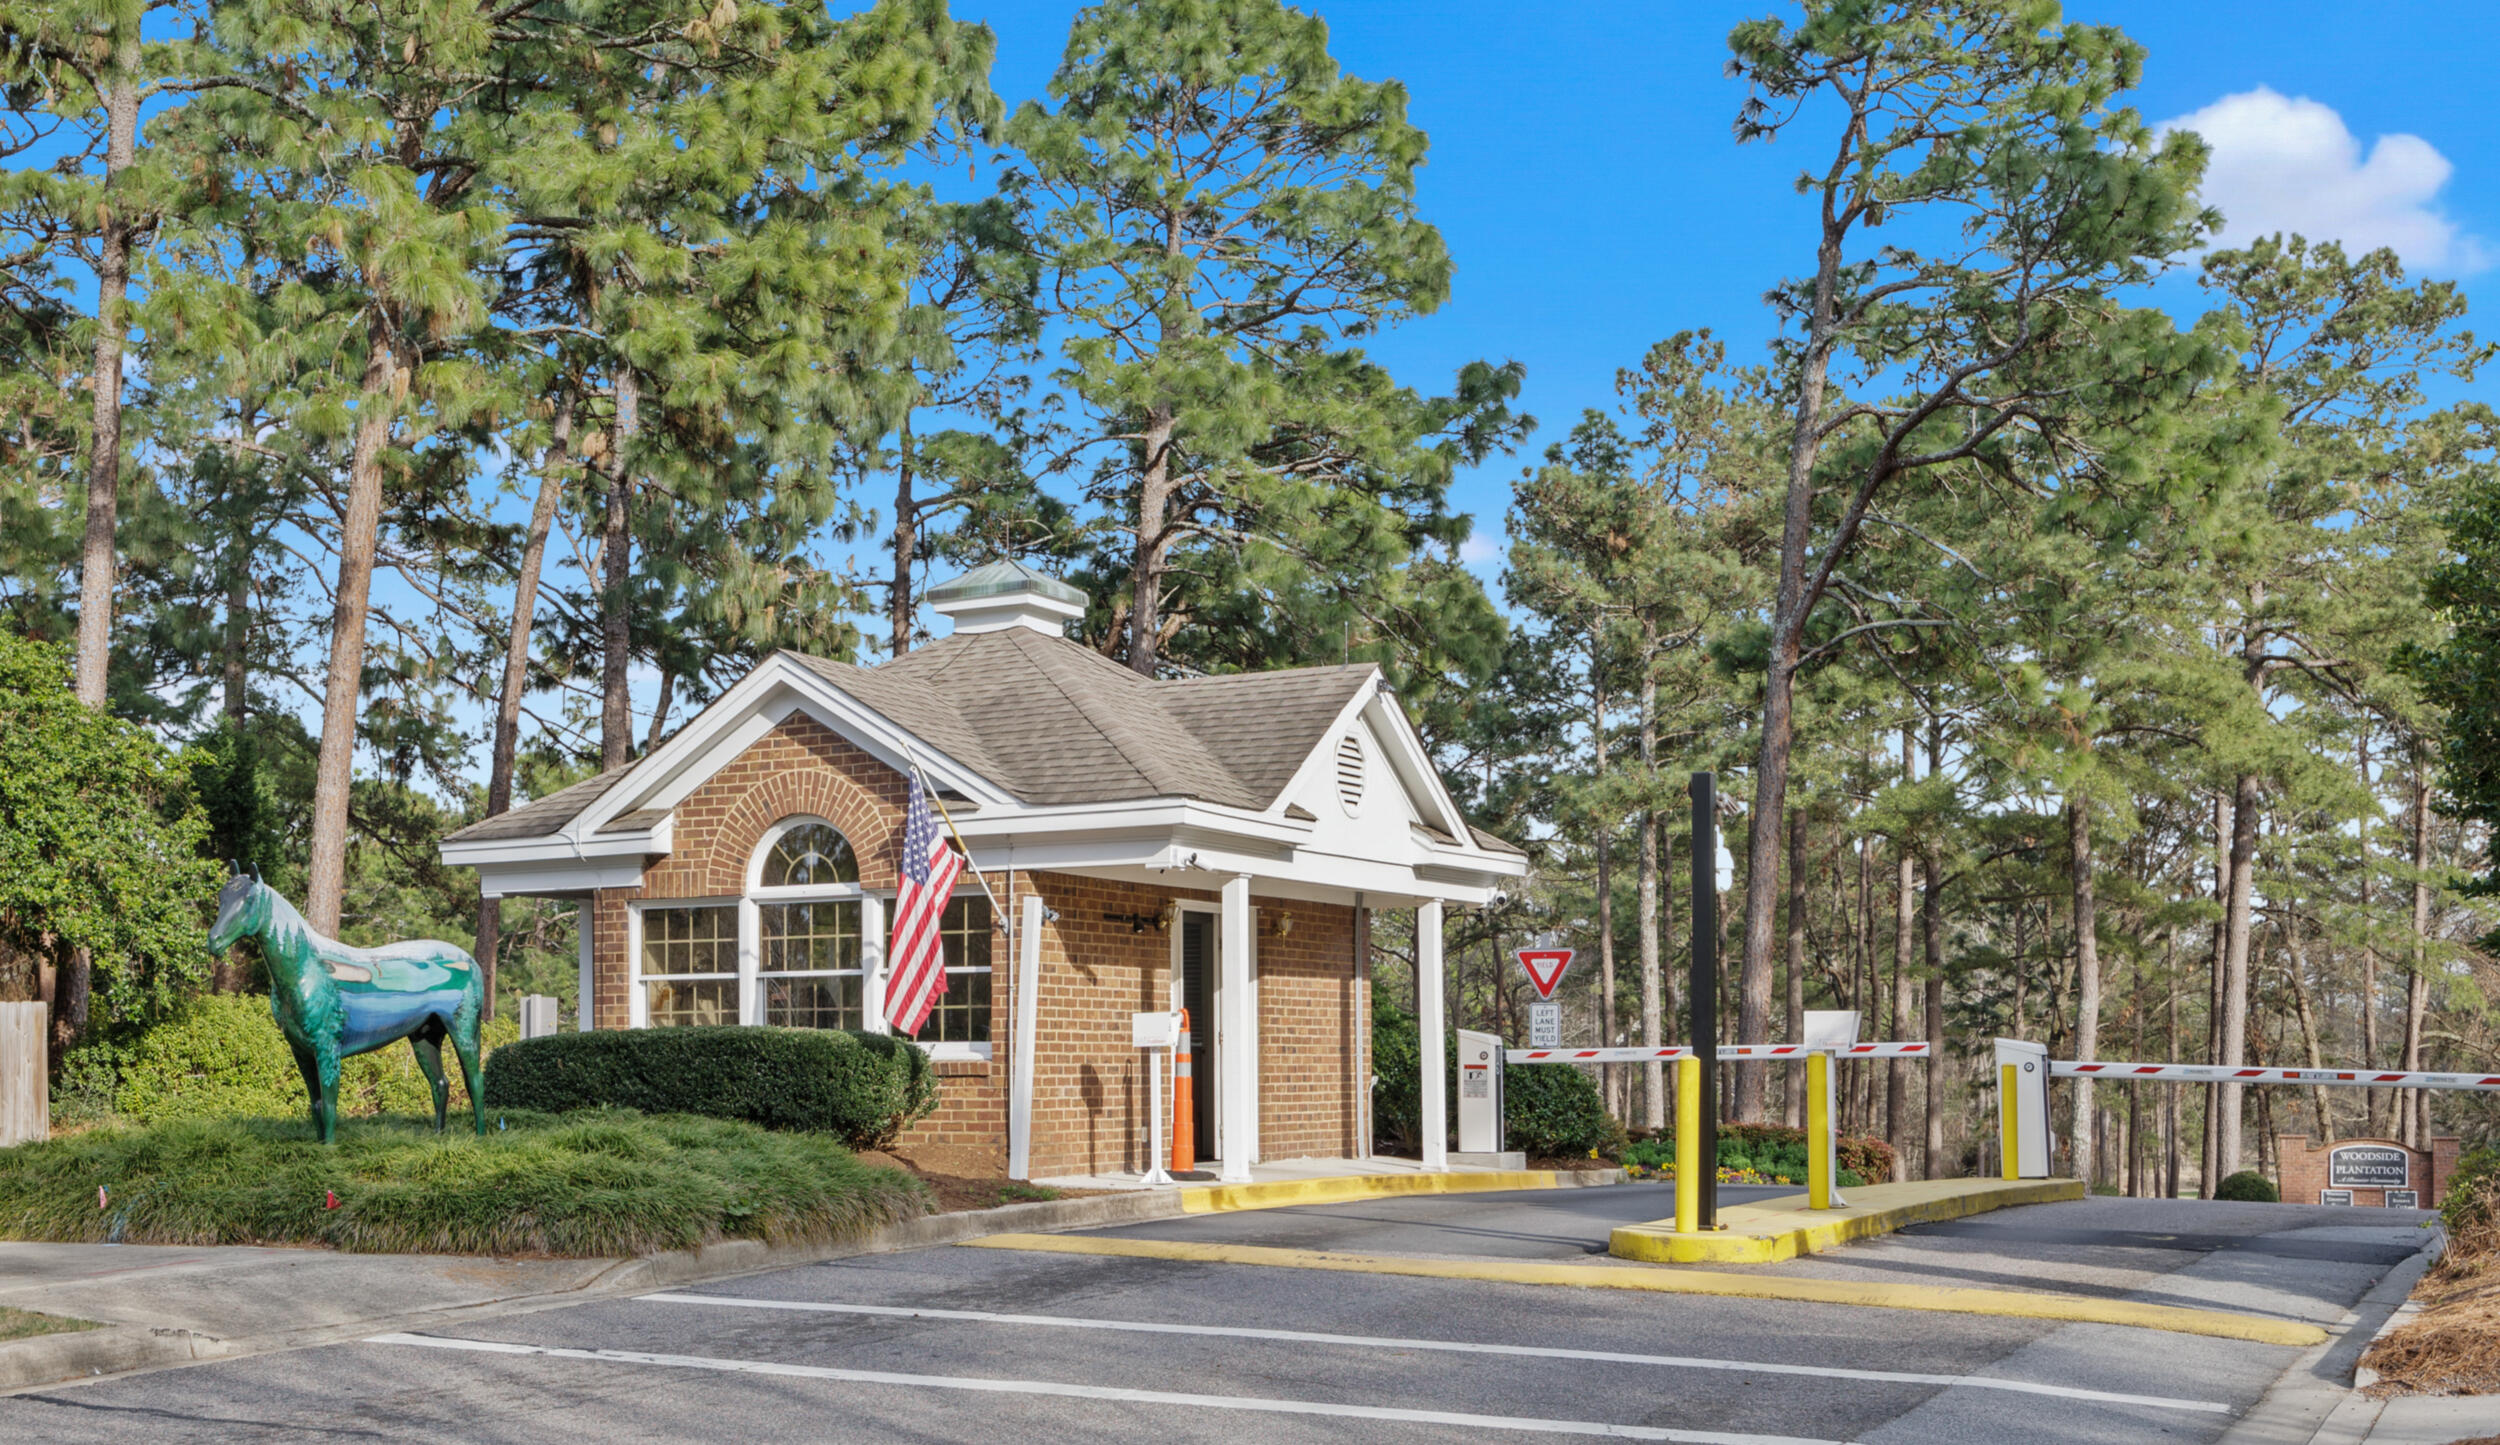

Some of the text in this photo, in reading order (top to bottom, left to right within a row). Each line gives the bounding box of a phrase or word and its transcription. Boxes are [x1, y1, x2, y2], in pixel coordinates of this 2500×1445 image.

[1535, 1009, 1554, 1017] LEFT
[2339, 1151, 2401, 1161] WOODSIDE
[2335, 1165, 2404, 1175] PLANTATION
